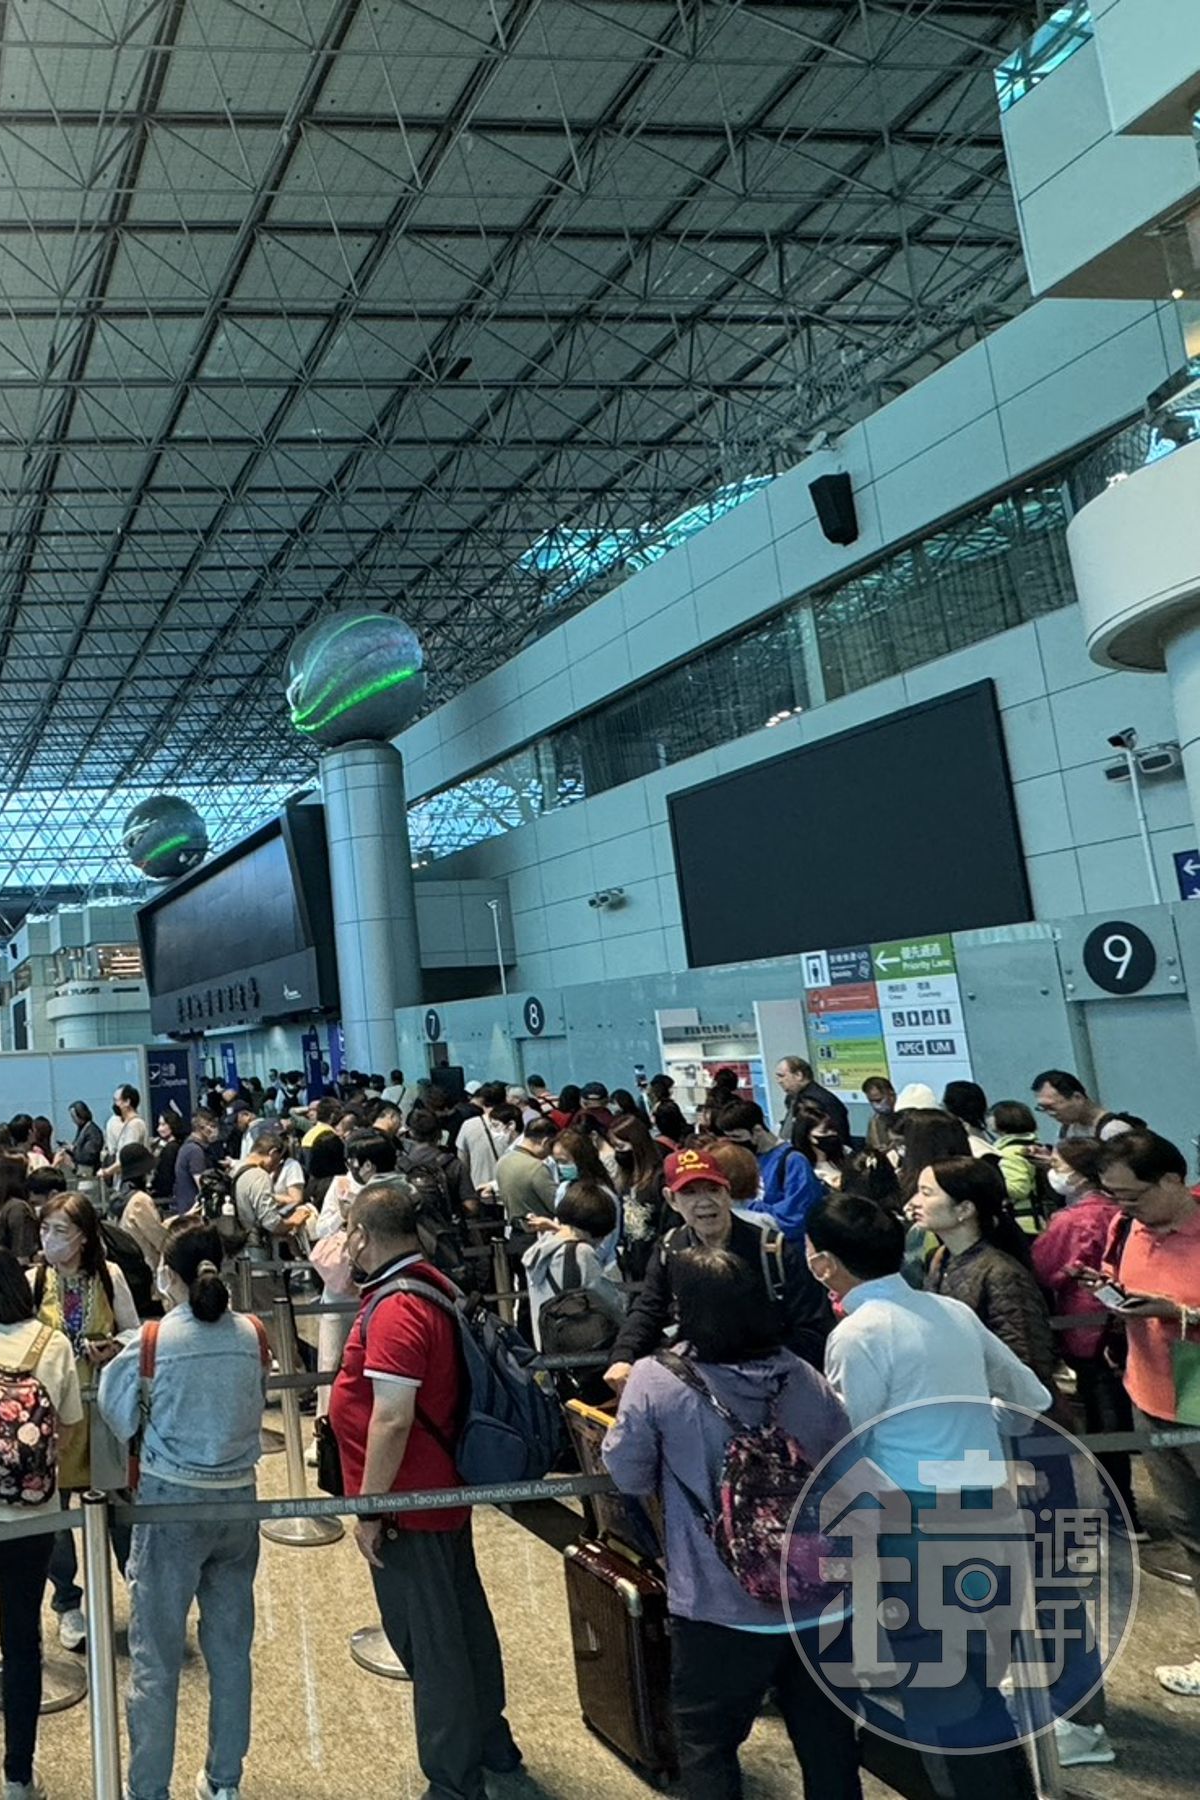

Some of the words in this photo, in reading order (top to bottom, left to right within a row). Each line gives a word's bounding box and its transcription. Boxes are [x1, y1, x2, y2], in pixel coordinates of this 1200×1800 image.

[1103, 935, 1133, 980] 9
[428, 1015, 435, 1036] 7
[529, 1003, 540, 1028] 8
[899, 1042, 924, 1054] APEC
[372, 1495, 410, 1508] Taiwan
[413, 1492, 458, 1508] Taoyuan
[461, 1486, 531, 1501] International
[533, 1482, 573, 1498] Airport
